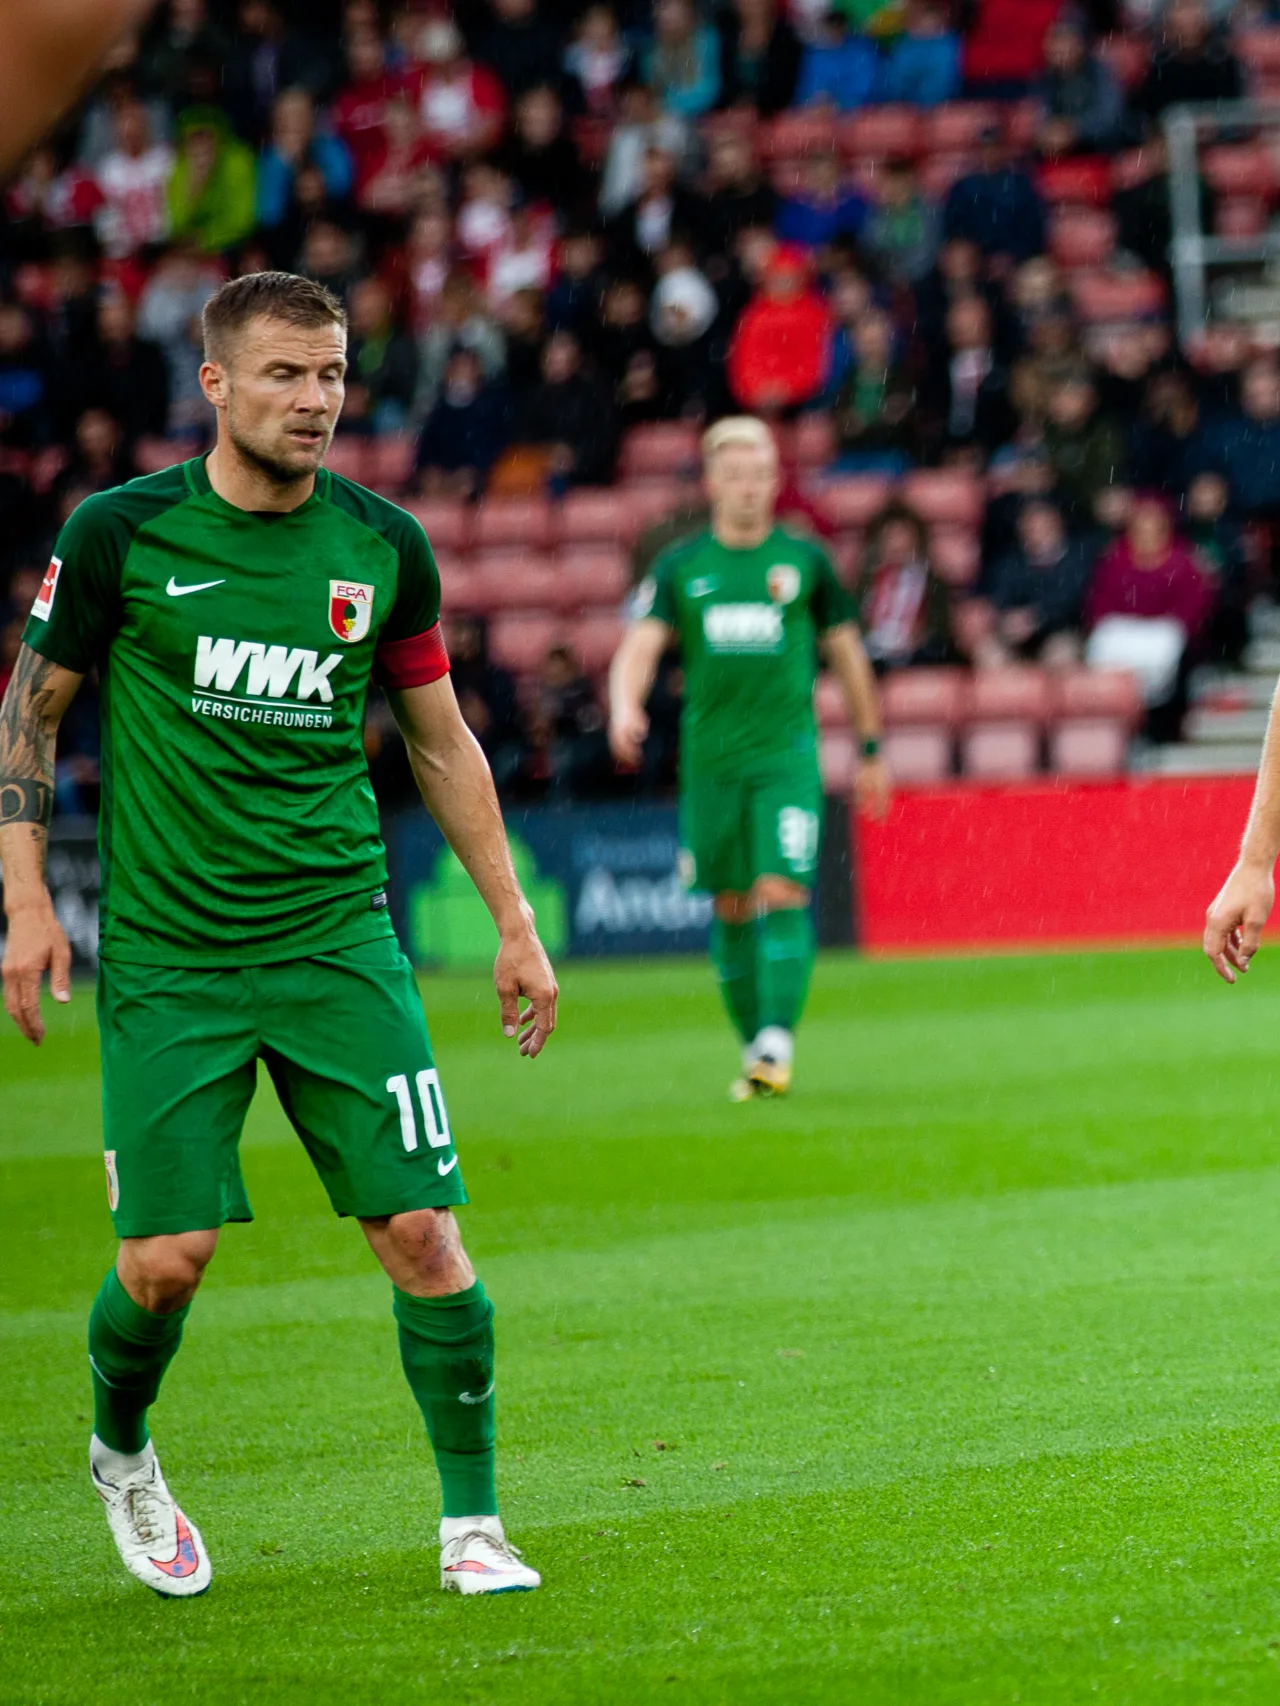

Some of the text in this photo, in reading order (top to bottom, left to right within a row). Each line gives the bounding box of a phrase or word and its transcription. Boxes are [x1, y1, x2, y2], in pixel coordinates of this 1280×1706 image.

[336, 585, 368, 601] FCA
[194, 635, 344, 703] WWK
[191, 698, 333, 729] VERSICHERUNGEN
[385, 1067, 452, 1153] 10
